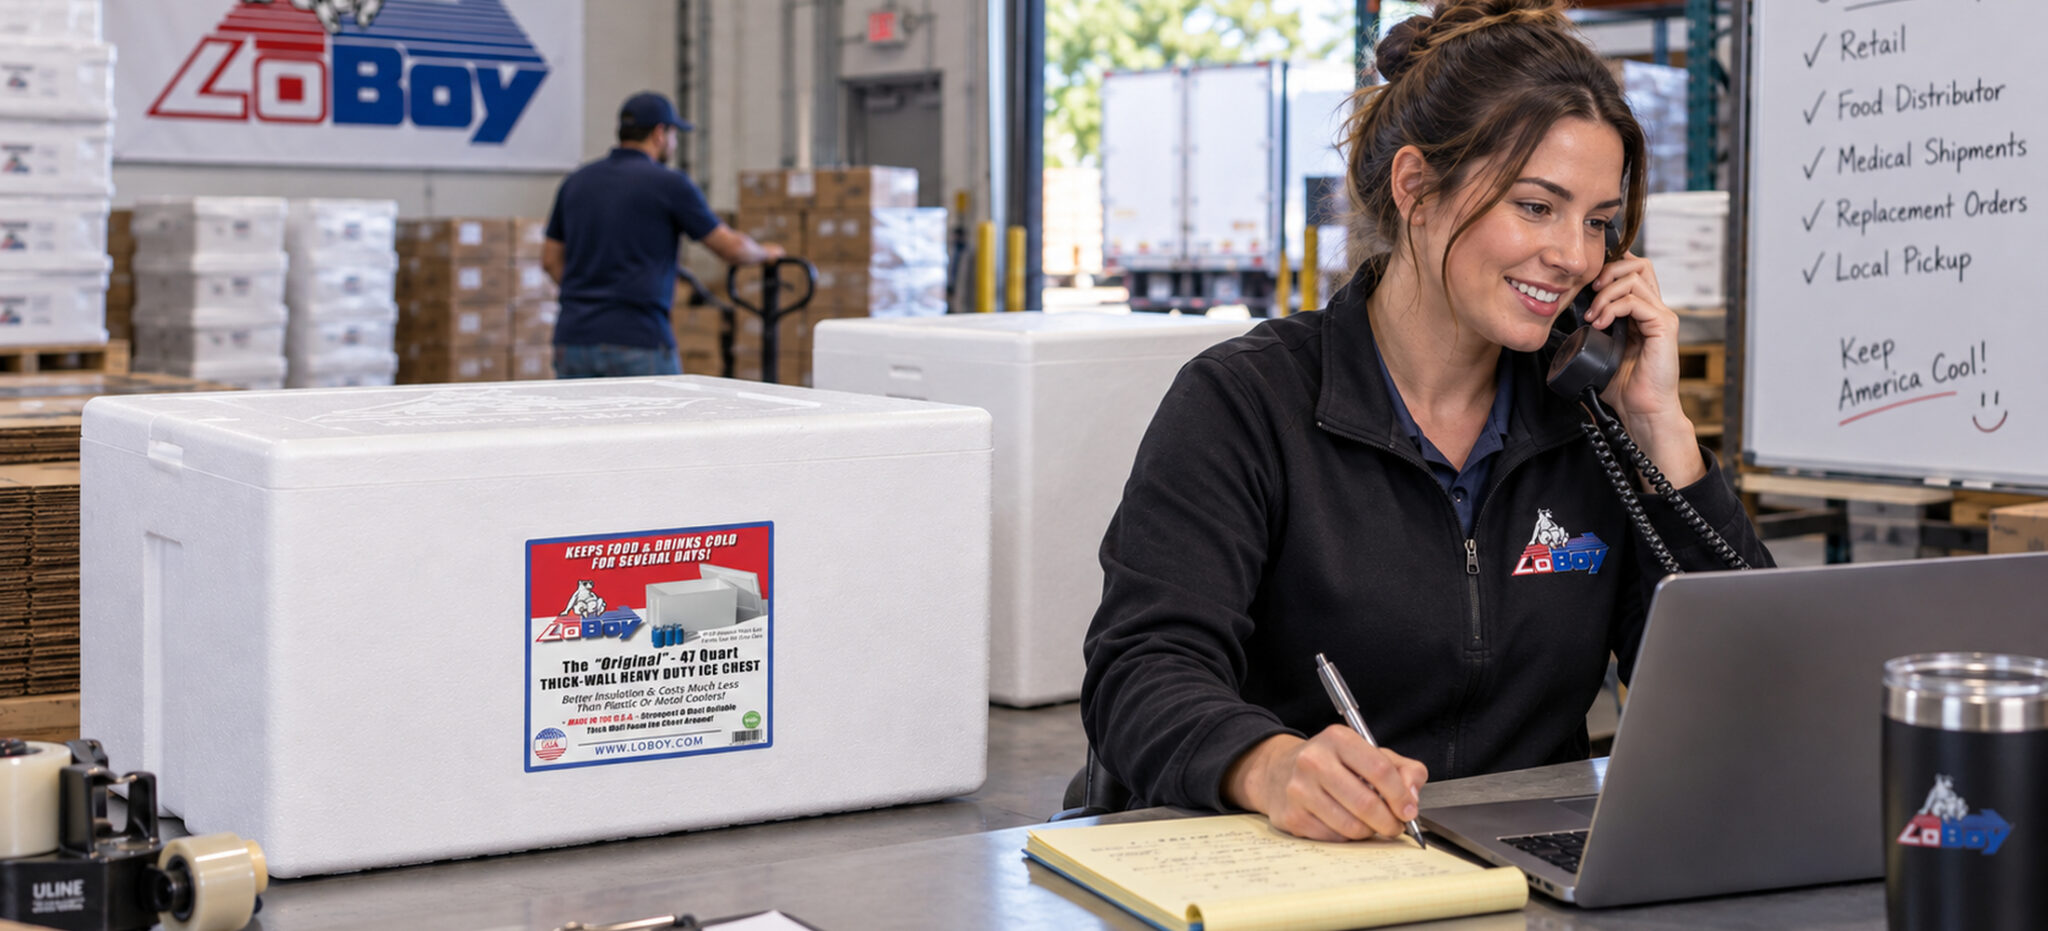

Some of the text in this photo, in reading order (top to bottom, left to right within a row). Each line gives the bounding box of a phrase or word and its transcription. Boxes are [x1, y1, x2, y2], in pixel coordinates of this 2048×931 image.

[1840, 24, 1905, 61] Retail
[1838, 78, 2006, 121] Food Distributor
[1837, 131, 2027, 174] Medical Shipments
[1837, 189, 2027, 236] Replacement Orders
[1836, 245, 1972, 283] Local Pickup
[1840, 336, 1895, 370] Keep
[1838, 340, 1986, 411] America Cool!
[565, 534, 737, 559] KEEPS FOOD & DRINKS COLD
[592, 548, 711, 570] FOR SEVERAL DAYS!
[540, 660, 761, 690] THICK-WALL HEAVY DUTY ICE CHEST
[562, 660, 588, 673] The
[680, 650, 696, 663] 47
[699, 647, 738, 662] Quart
[562, 694, 593, 704] Better
[646, 687, 655, 696] &
[658, 686, 685, 695] Costs
[688, 681, 716, 693] Much
[718, 681, 739, 690] Less
[577, 703, 602, 713] Than
[640, 698, 652, 707] Or
[595, 736, 703, 755] WWW.LOBOY.COM
[33, 879, 84, 899] ULINE
